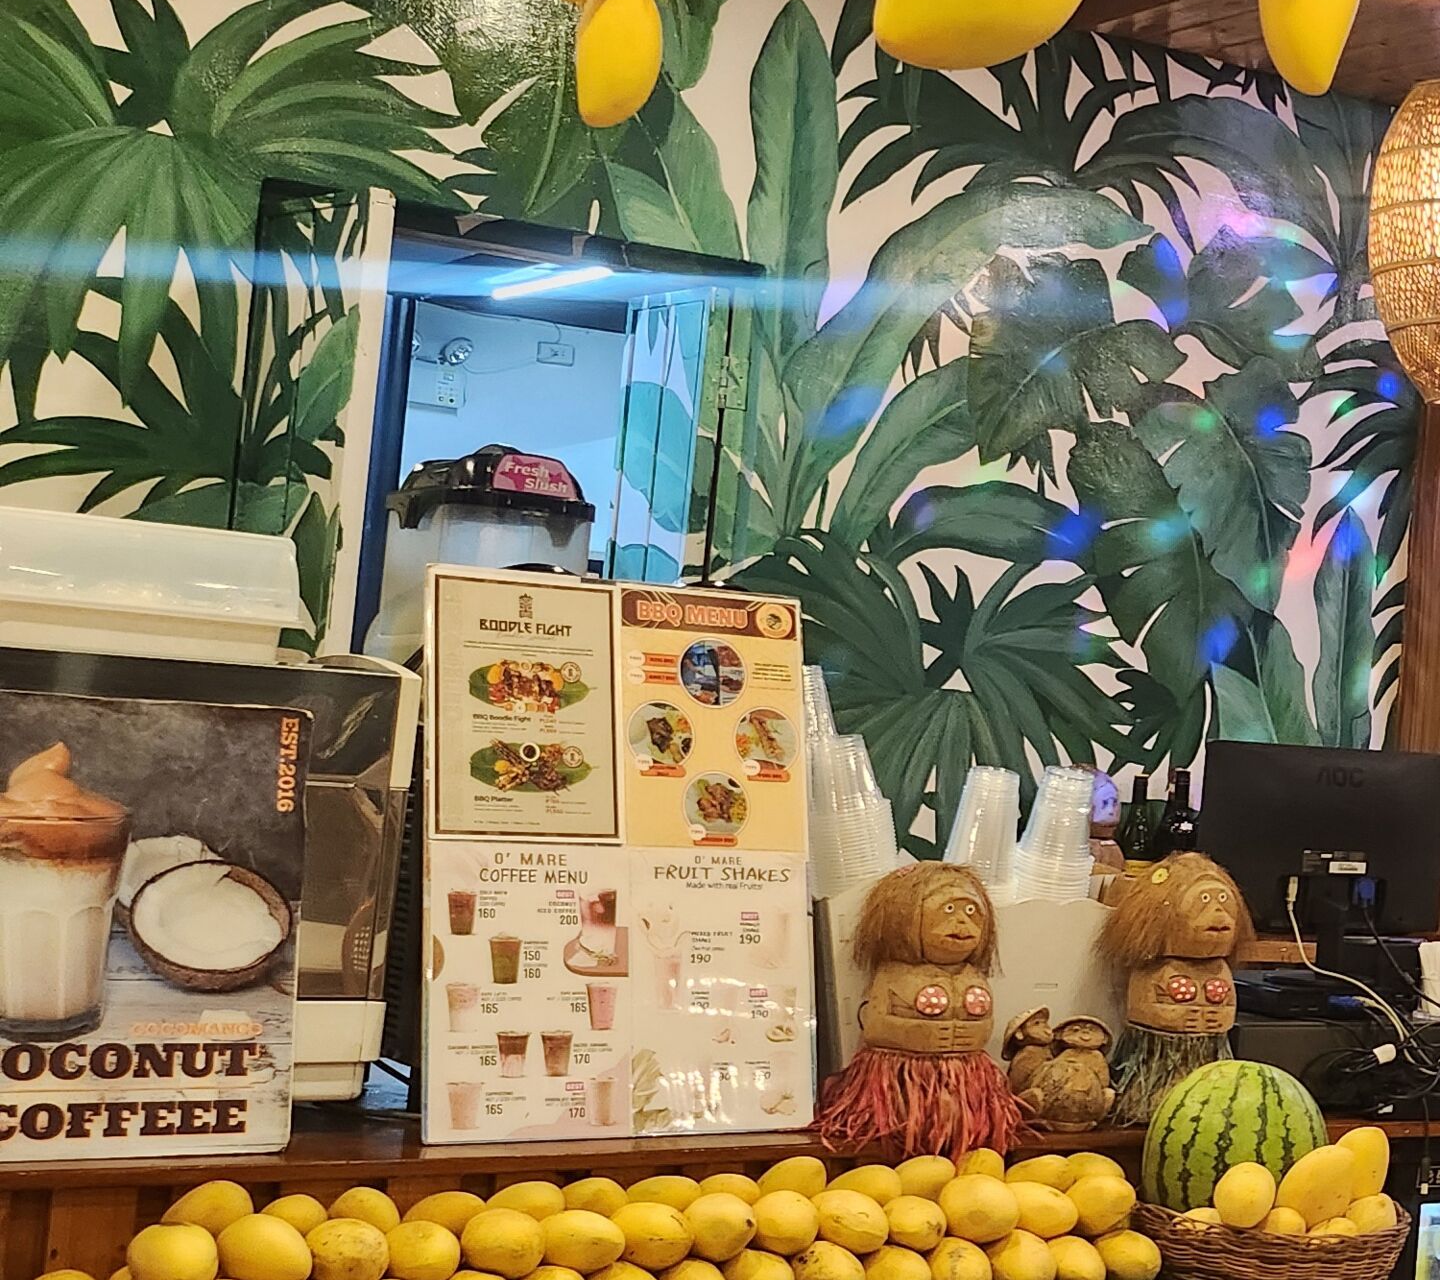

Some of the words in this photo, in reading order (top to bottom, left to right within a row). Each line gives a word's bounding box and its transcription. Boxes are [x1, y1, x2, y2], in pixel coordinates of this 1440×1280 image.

[504, 461, 549, 478] Fresh
[524, 477, 568, 494] Slush
[637, 600, 683, 627] BBQ
[686, 604, 748, 629] MENU
[480, 619, 533, 634] BOODLE
[536, 623, 572, 637] FIGHT
[1315, 767, 1364, 788] AOC
[520, 852, 568, 867] MARE
[711, 856, 742, 866] MARE
[479, 868, 538, 883] COFFEE
[544, 870, 589, 885] MENU
[653, 865, 713, 880] FRUIT
[721, 867, 792, 883] SHAKES
[478, 908, 496, 919] 160
[560, 914, 579, 925] 200
[739, 934, 761, 945] 190
[524, 951, 541, 961] 150
[690, 953, 712, 963] 190
[524, 968, 541, 979] 160
[481, 1003, 498, 1014] 165
[570, 1002, 587, 1013] 165
[479, 1055, 498, 1066] 165
[574, 1053, 590, 1064] 170
[485, 1104, 503, 1115] 165
[569, 1107, 586, 1118] 170
